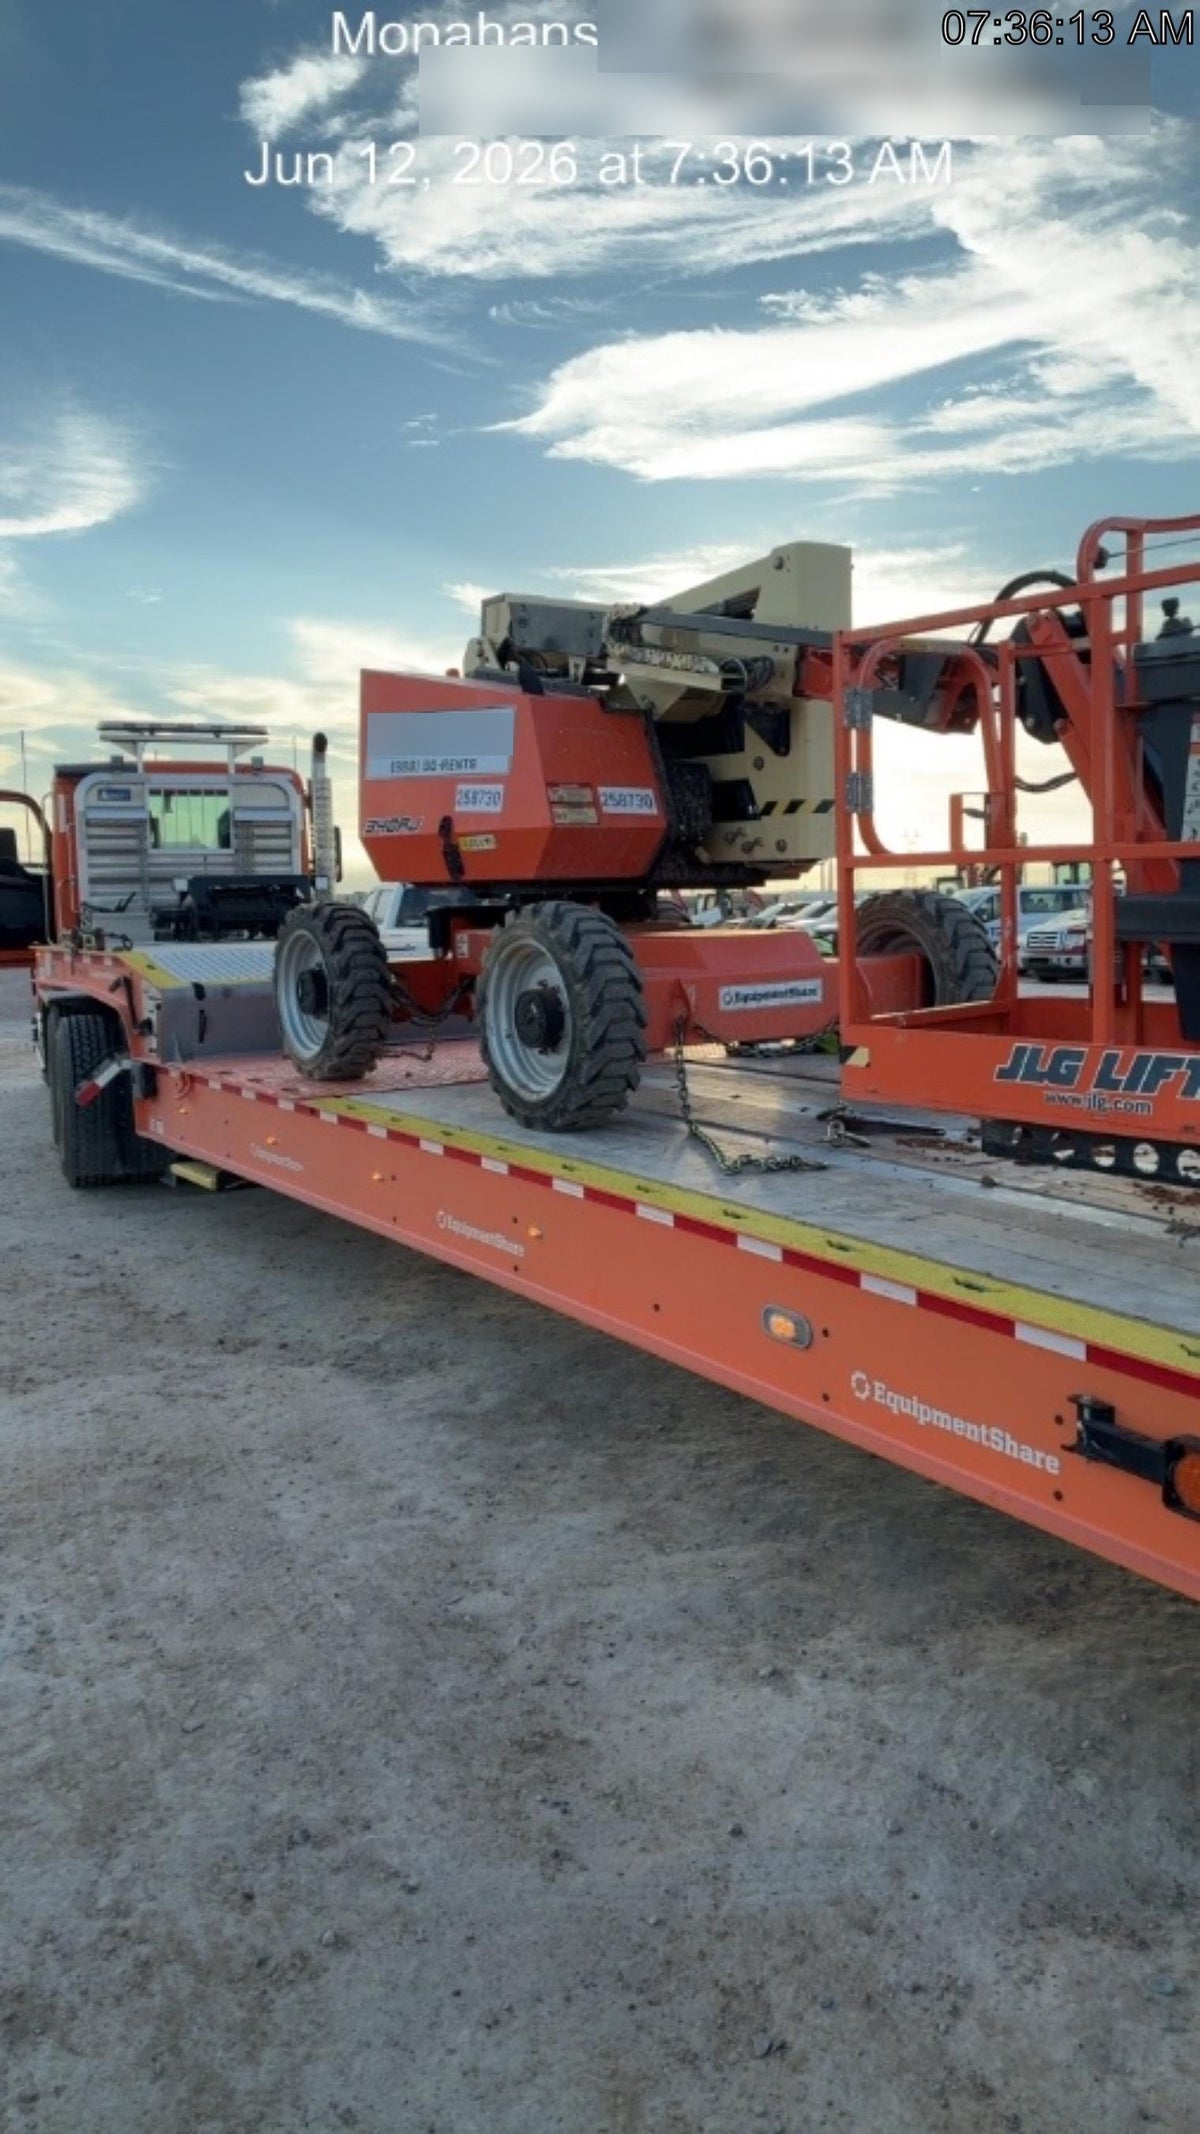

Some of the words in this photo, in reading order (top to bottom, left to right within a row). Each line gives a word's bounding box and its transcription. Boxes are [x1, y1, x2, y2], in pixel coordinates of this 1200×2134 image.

[602, 791, 653, 809] 258730
[993, 1043, 1089, 1088] JLG
[1044, 1091, 1153, 1115] www.jlg.com
[872, 1382, 1060, 1475] EquipmentShare
